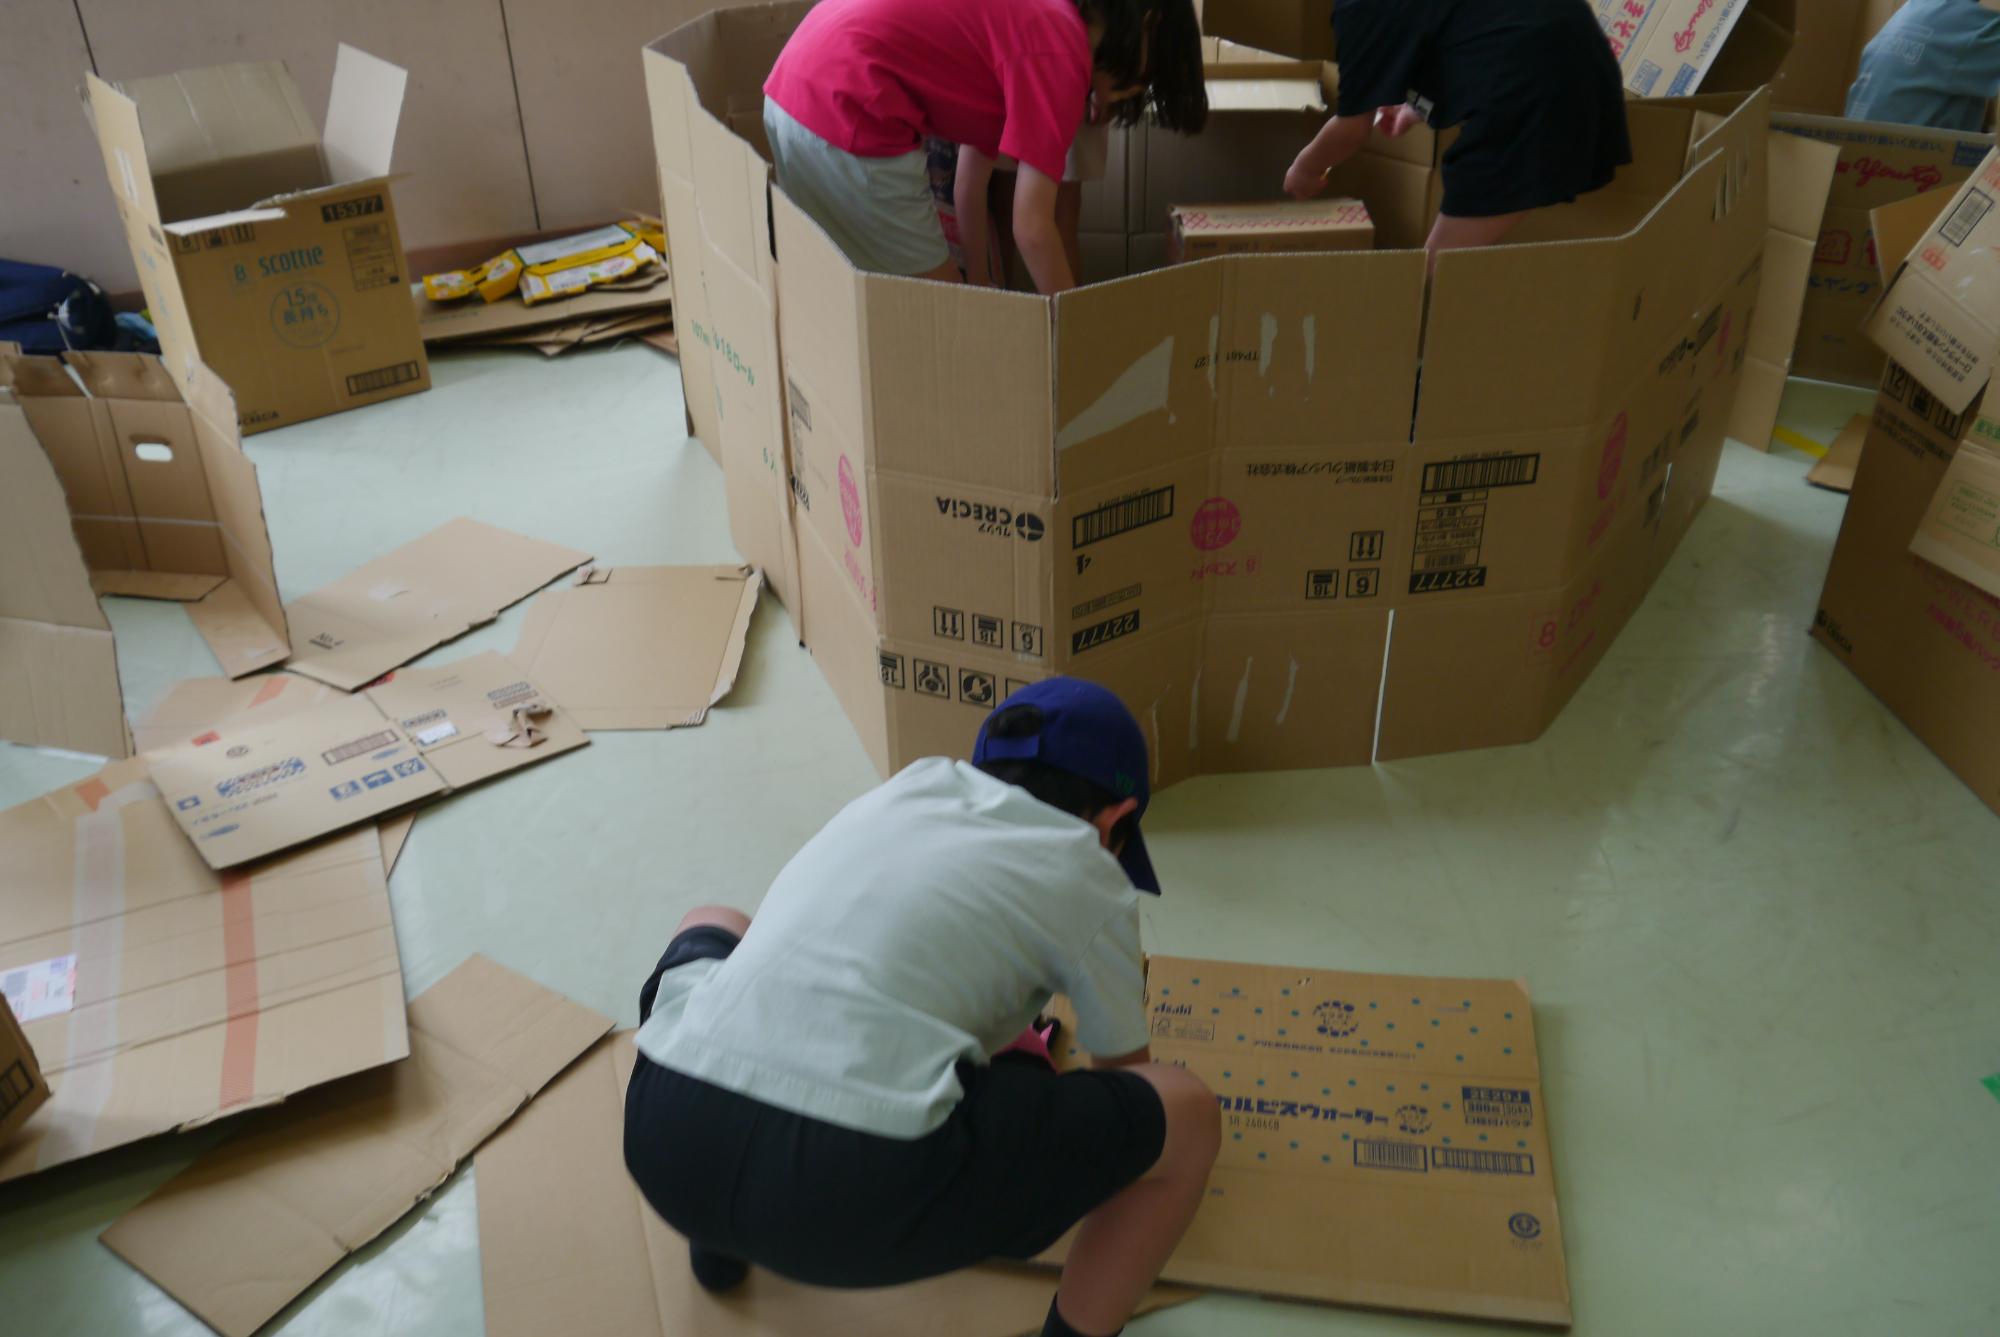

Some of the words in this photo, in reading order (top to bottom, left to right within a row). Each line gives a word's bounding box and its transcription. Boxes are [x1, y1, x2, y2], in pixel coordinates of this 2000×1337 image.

[1247, 459, 1395, 477] 日本製紙クレシア株式会社
[1411, 568, 1484, 593] 22777
[1075, 611, 1138, 653] 22777
